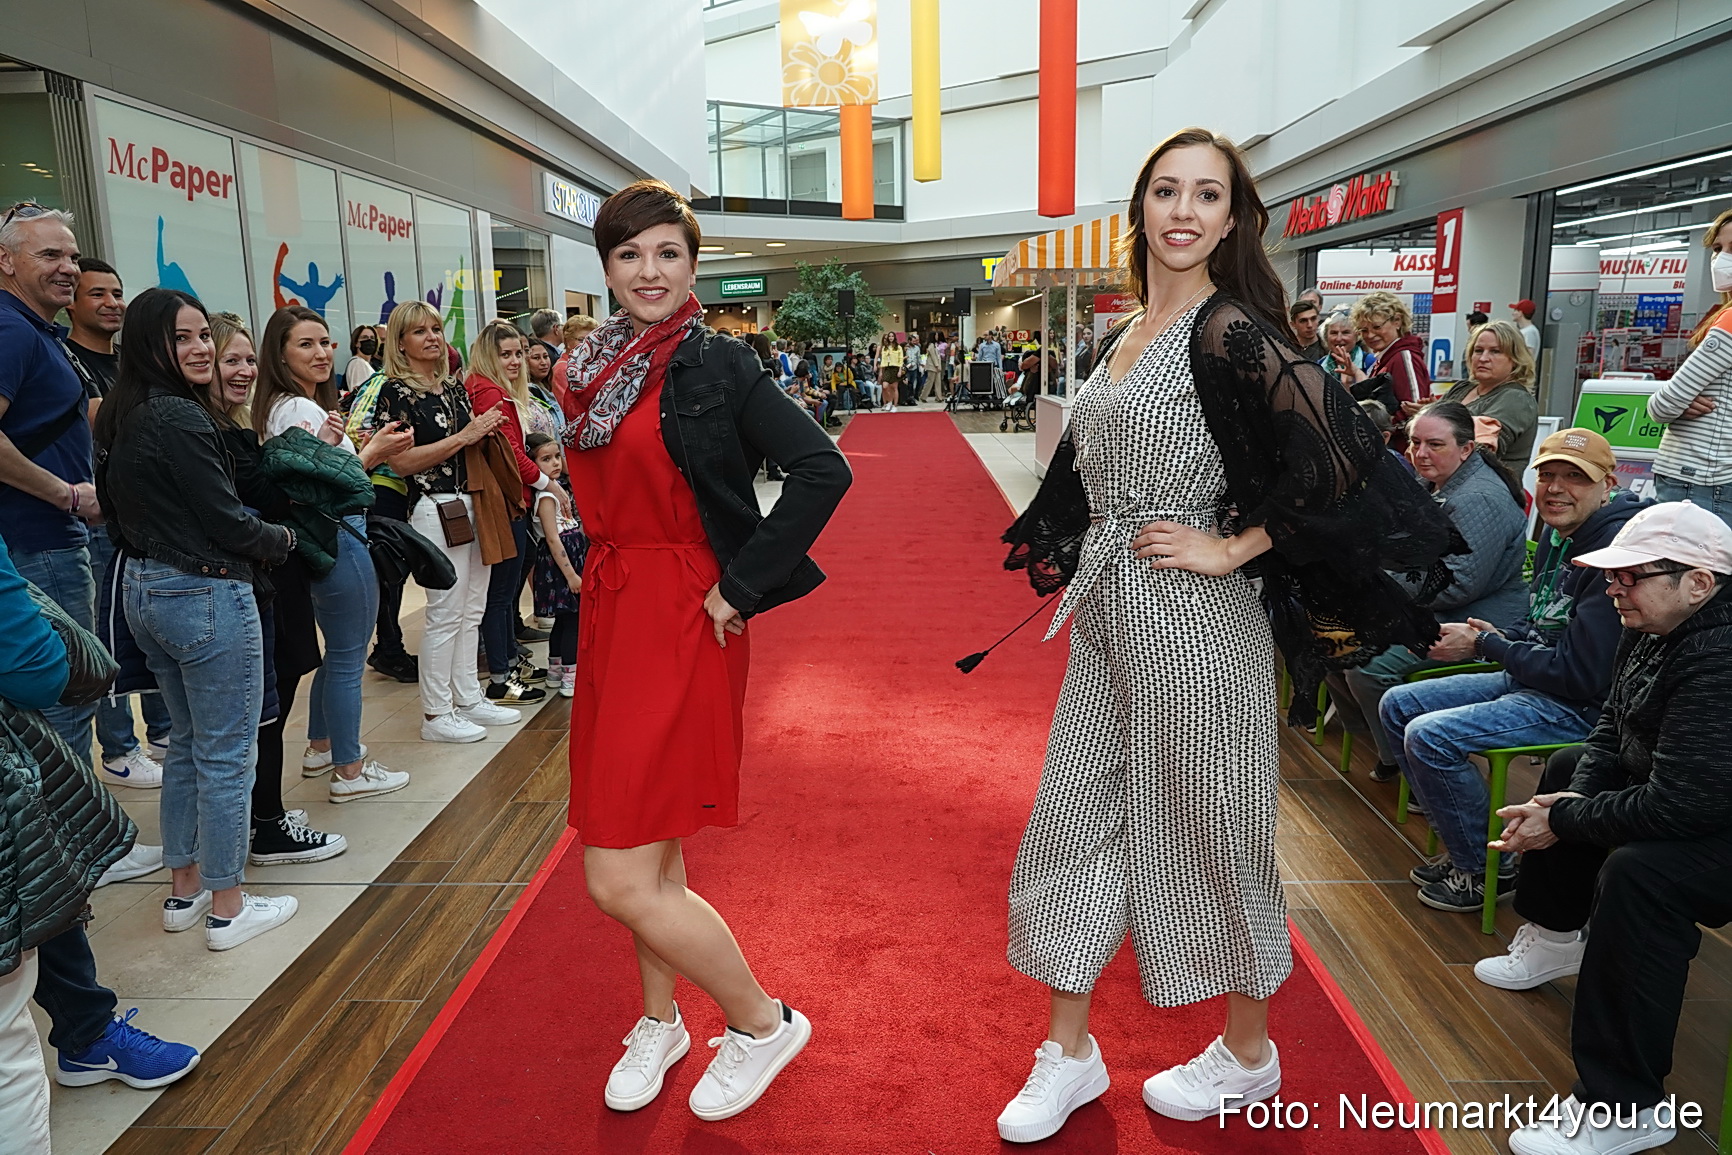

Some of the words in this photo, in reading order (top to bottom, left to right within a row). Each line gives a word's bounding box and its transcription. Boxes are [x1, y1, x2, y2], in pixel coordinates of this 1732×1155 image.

[107, 137, 233, 201] McPaper
[347, 200, 412, 242] McPaper
[553, 181, 599, 223] STARCUT
[1442, 217, 1457, 269] 1
[724, 282, 761, 291] LEBENSRAUM
[981, 257, 1005, 281] T
[1319, 279, 1404, 291] Online-Abholung
